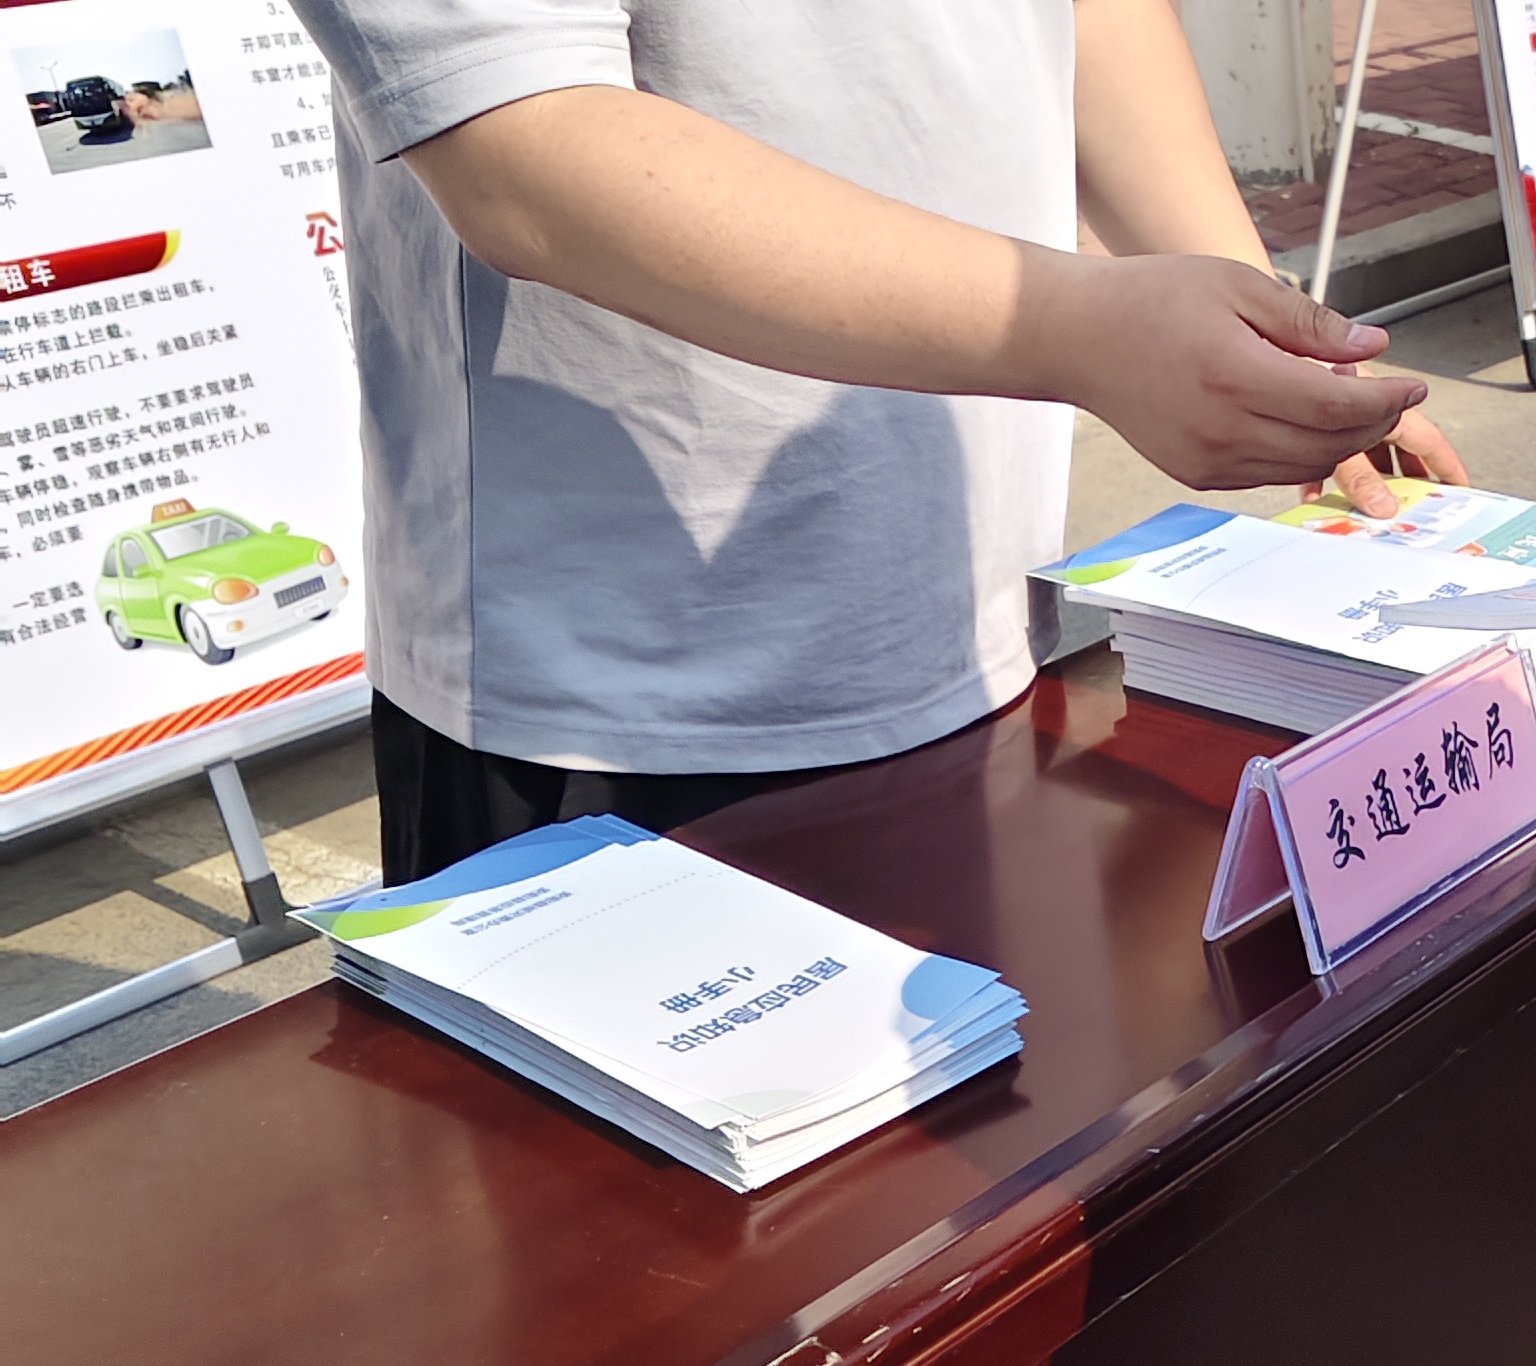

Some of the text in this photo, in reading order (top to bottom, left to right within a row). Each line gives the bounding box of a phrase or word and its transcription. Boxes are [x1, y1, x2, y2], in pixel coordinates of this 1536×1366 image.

[1324, 701, 1515, 870] 交通运输局
[656, 957, 848, 1054] 居民应急知识
[659, 966, 756, 1014] 小手册
